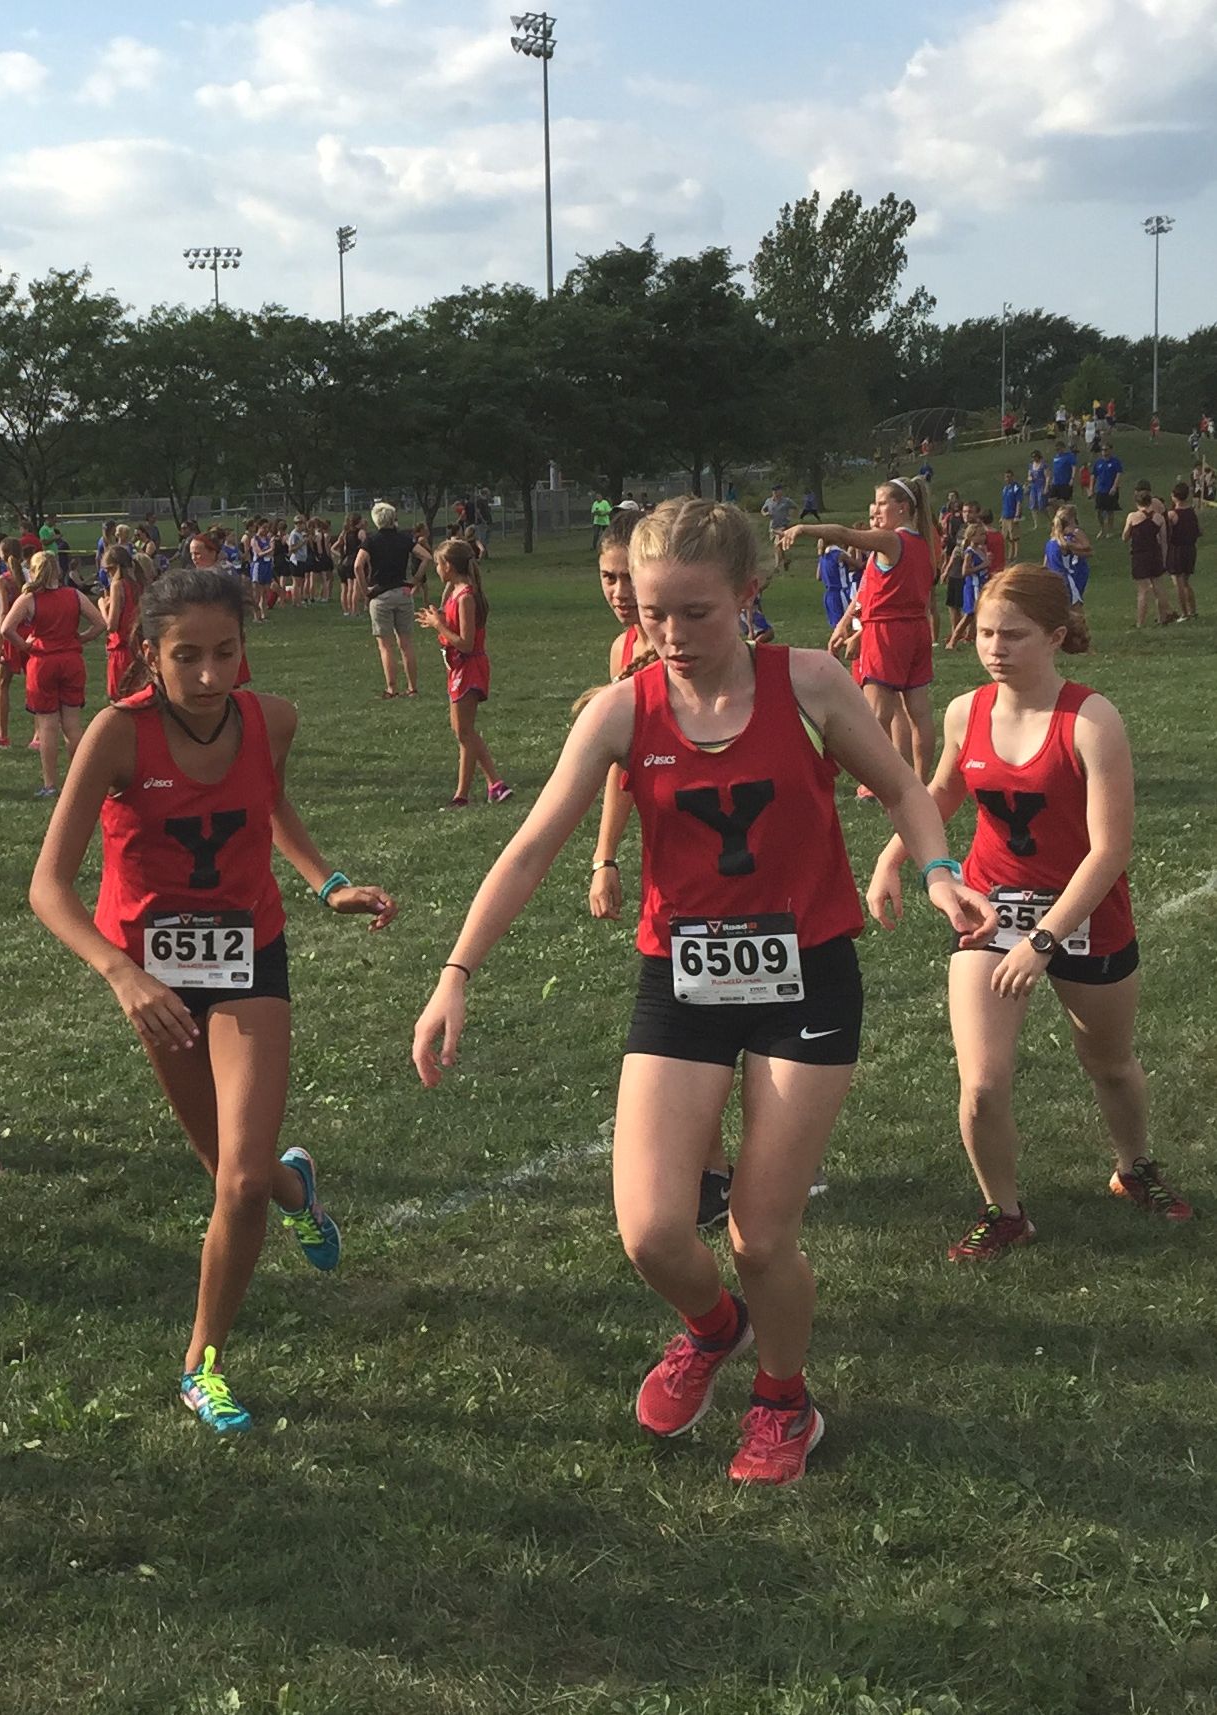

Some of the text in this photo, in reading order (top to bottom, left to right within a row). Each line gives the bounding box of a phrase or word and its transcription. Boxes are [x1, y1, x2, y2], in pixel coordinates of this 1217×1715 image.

[653, 755, 676, 764] asics
[153, 780, 173, 788] asics
[675, 779, 775, 877] Y
[975, 788, 1046, 857] Y
[164, 809, 247, 889] Y
[151, 930, 244, 961] 6512
[680, 938, 788, 976] 6509
